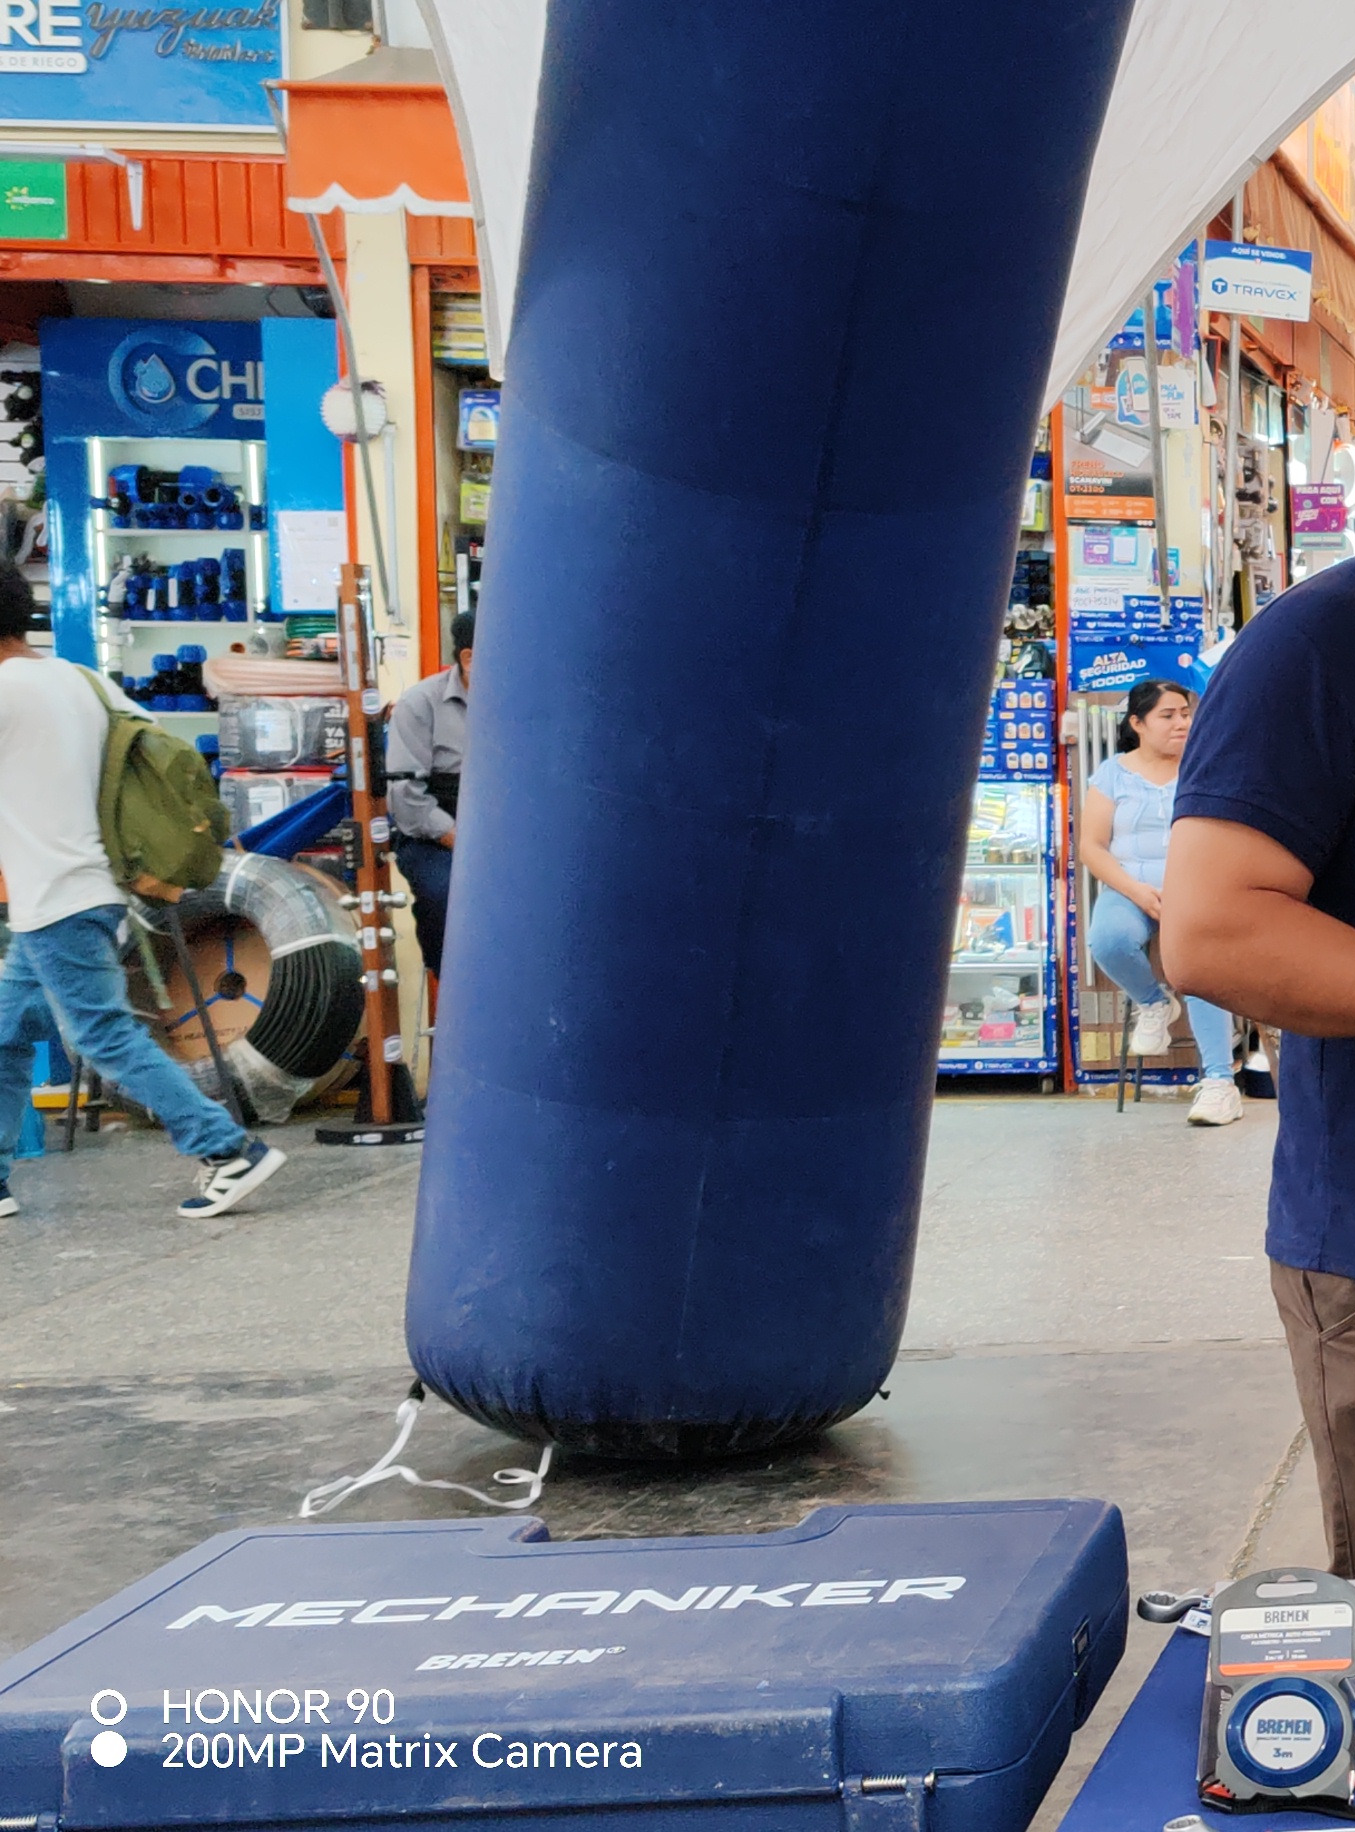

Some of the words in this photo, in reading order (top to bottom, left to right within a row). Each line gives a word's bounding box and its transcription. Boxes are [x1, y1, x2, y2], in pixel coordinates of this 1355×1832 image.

[9, 57, 27, 67] DE
[32, 57, 78, 68] RIEGO
[1232, 283, 1297, 301] TRAVEX
[1094, 652, 1128, 667] ALTA
[1079, 659, 1146, 678] SEGURIDAD
[165, 1576, 966, 1630] MECHANIKER
[1264, 1610, 1309, 1623] BREMEN
[415, 1648, 606, 1671] BREMEN
[1257, 1719, 1313, 1735] BREMEN
